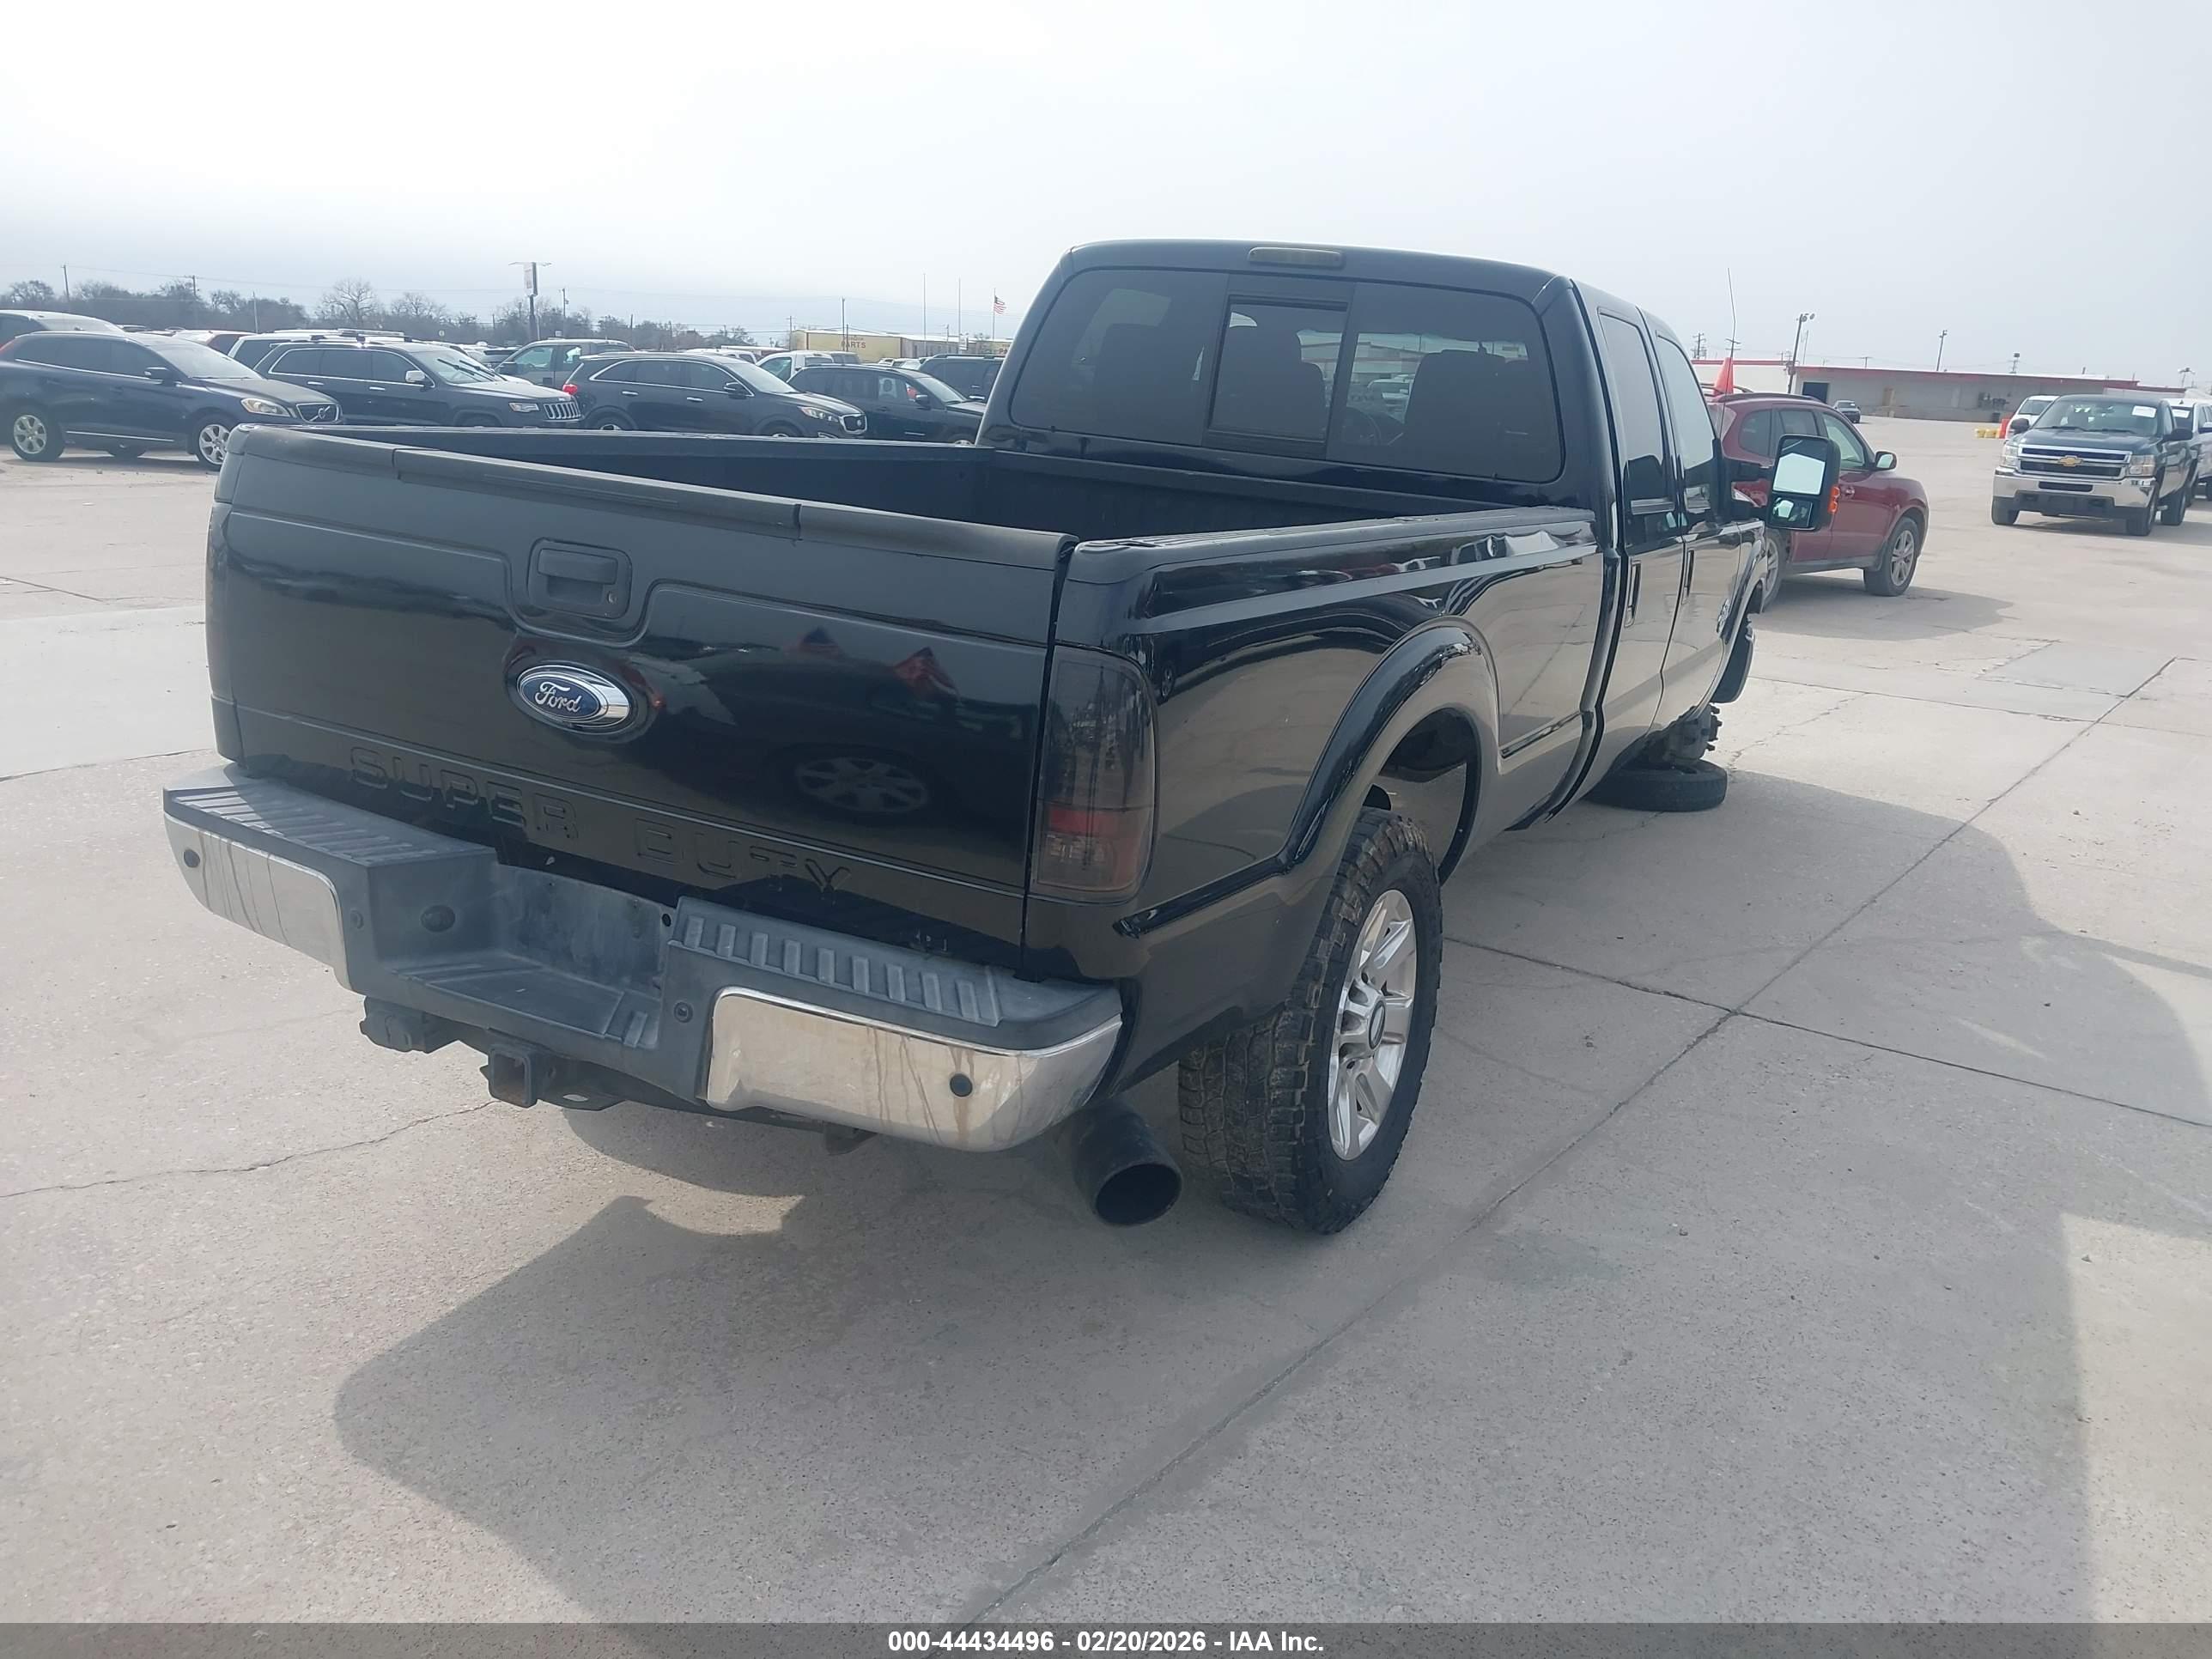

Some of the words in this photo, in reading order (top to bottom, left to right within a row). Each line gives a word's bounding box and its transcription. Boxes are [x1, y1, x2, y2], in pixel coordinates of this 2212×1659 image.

[535, 682, 582, 713] Ford
[350, 747, 579, 841] SUPER
[635, 817, 852, 903] DUTY
